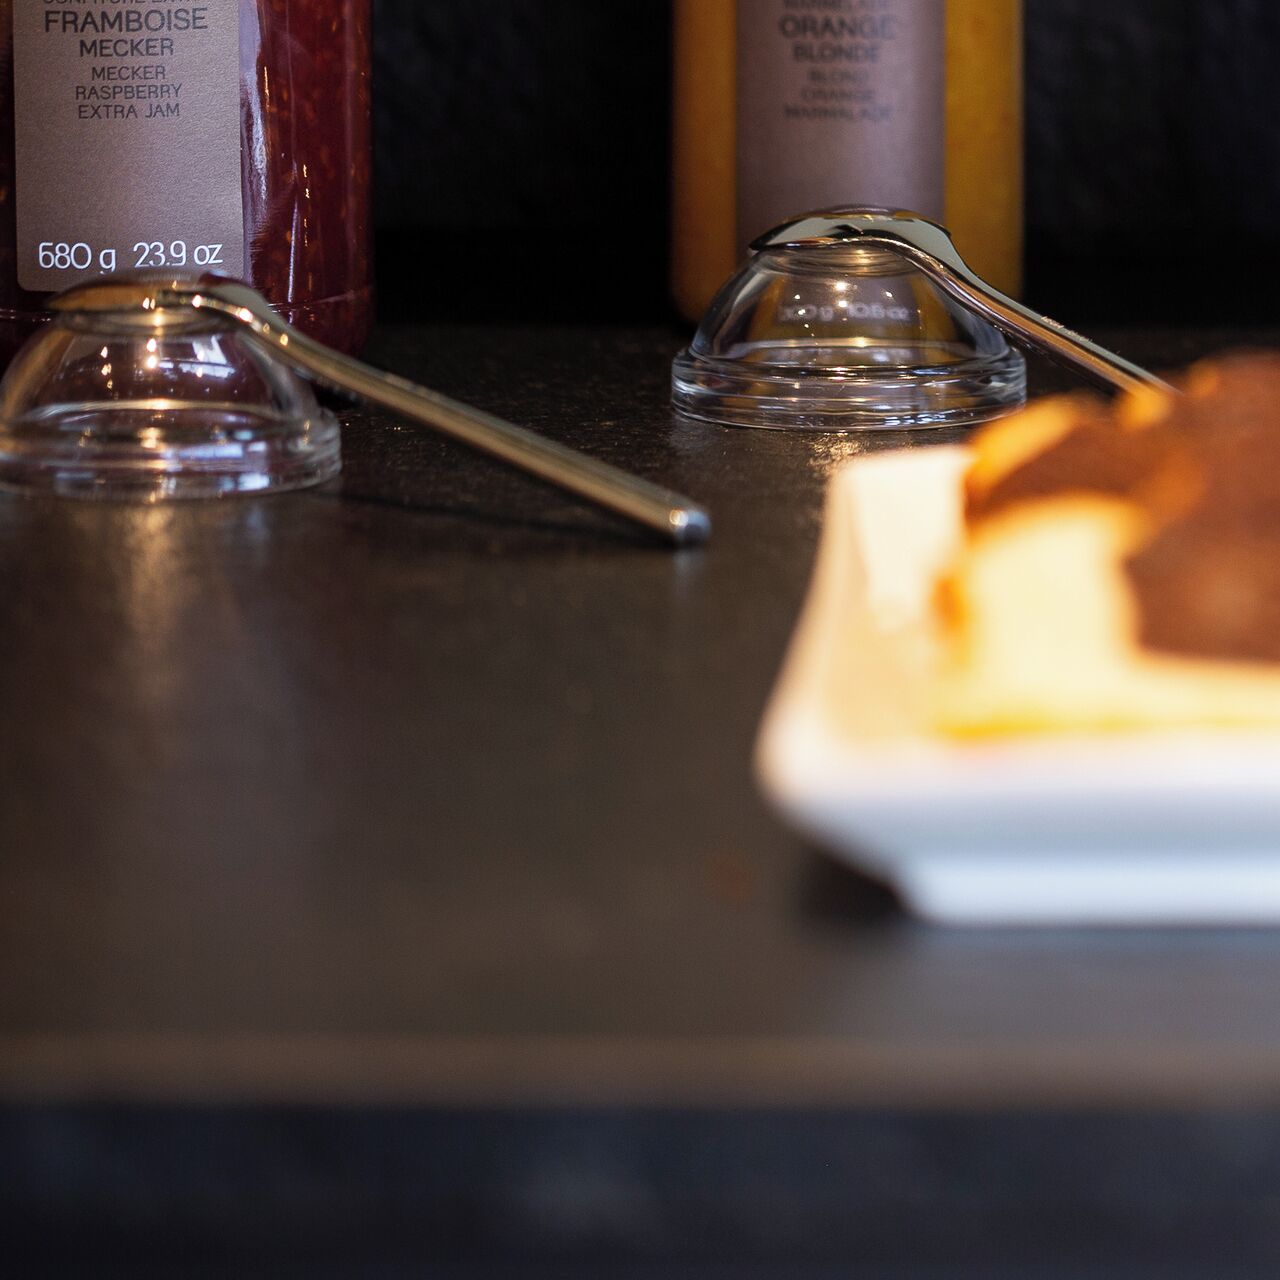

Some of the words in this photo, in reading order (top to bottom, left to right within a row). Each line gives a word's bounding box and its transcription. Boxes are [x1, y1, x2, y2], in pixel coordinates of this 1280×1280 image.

[44, 7, 208, 33] FRAMBOISE
[778, 14, 897, 39] ORANGE
[79, 37, 174, 58] MECKER
[793, 42, 880, 64] BLONDE
[91, 65, 166, 81] MECKER
[75, 83, 182, 101] RASPBERRY
[78, 104, 138, 120] EXTRA
[145, 102, 181, 118] JAM
[38, 242, 93, 269] 680
[99, 248, 117, 274] g
[132, 240, 188, 268] 23.9
[193, 243, 224, 265] oz
